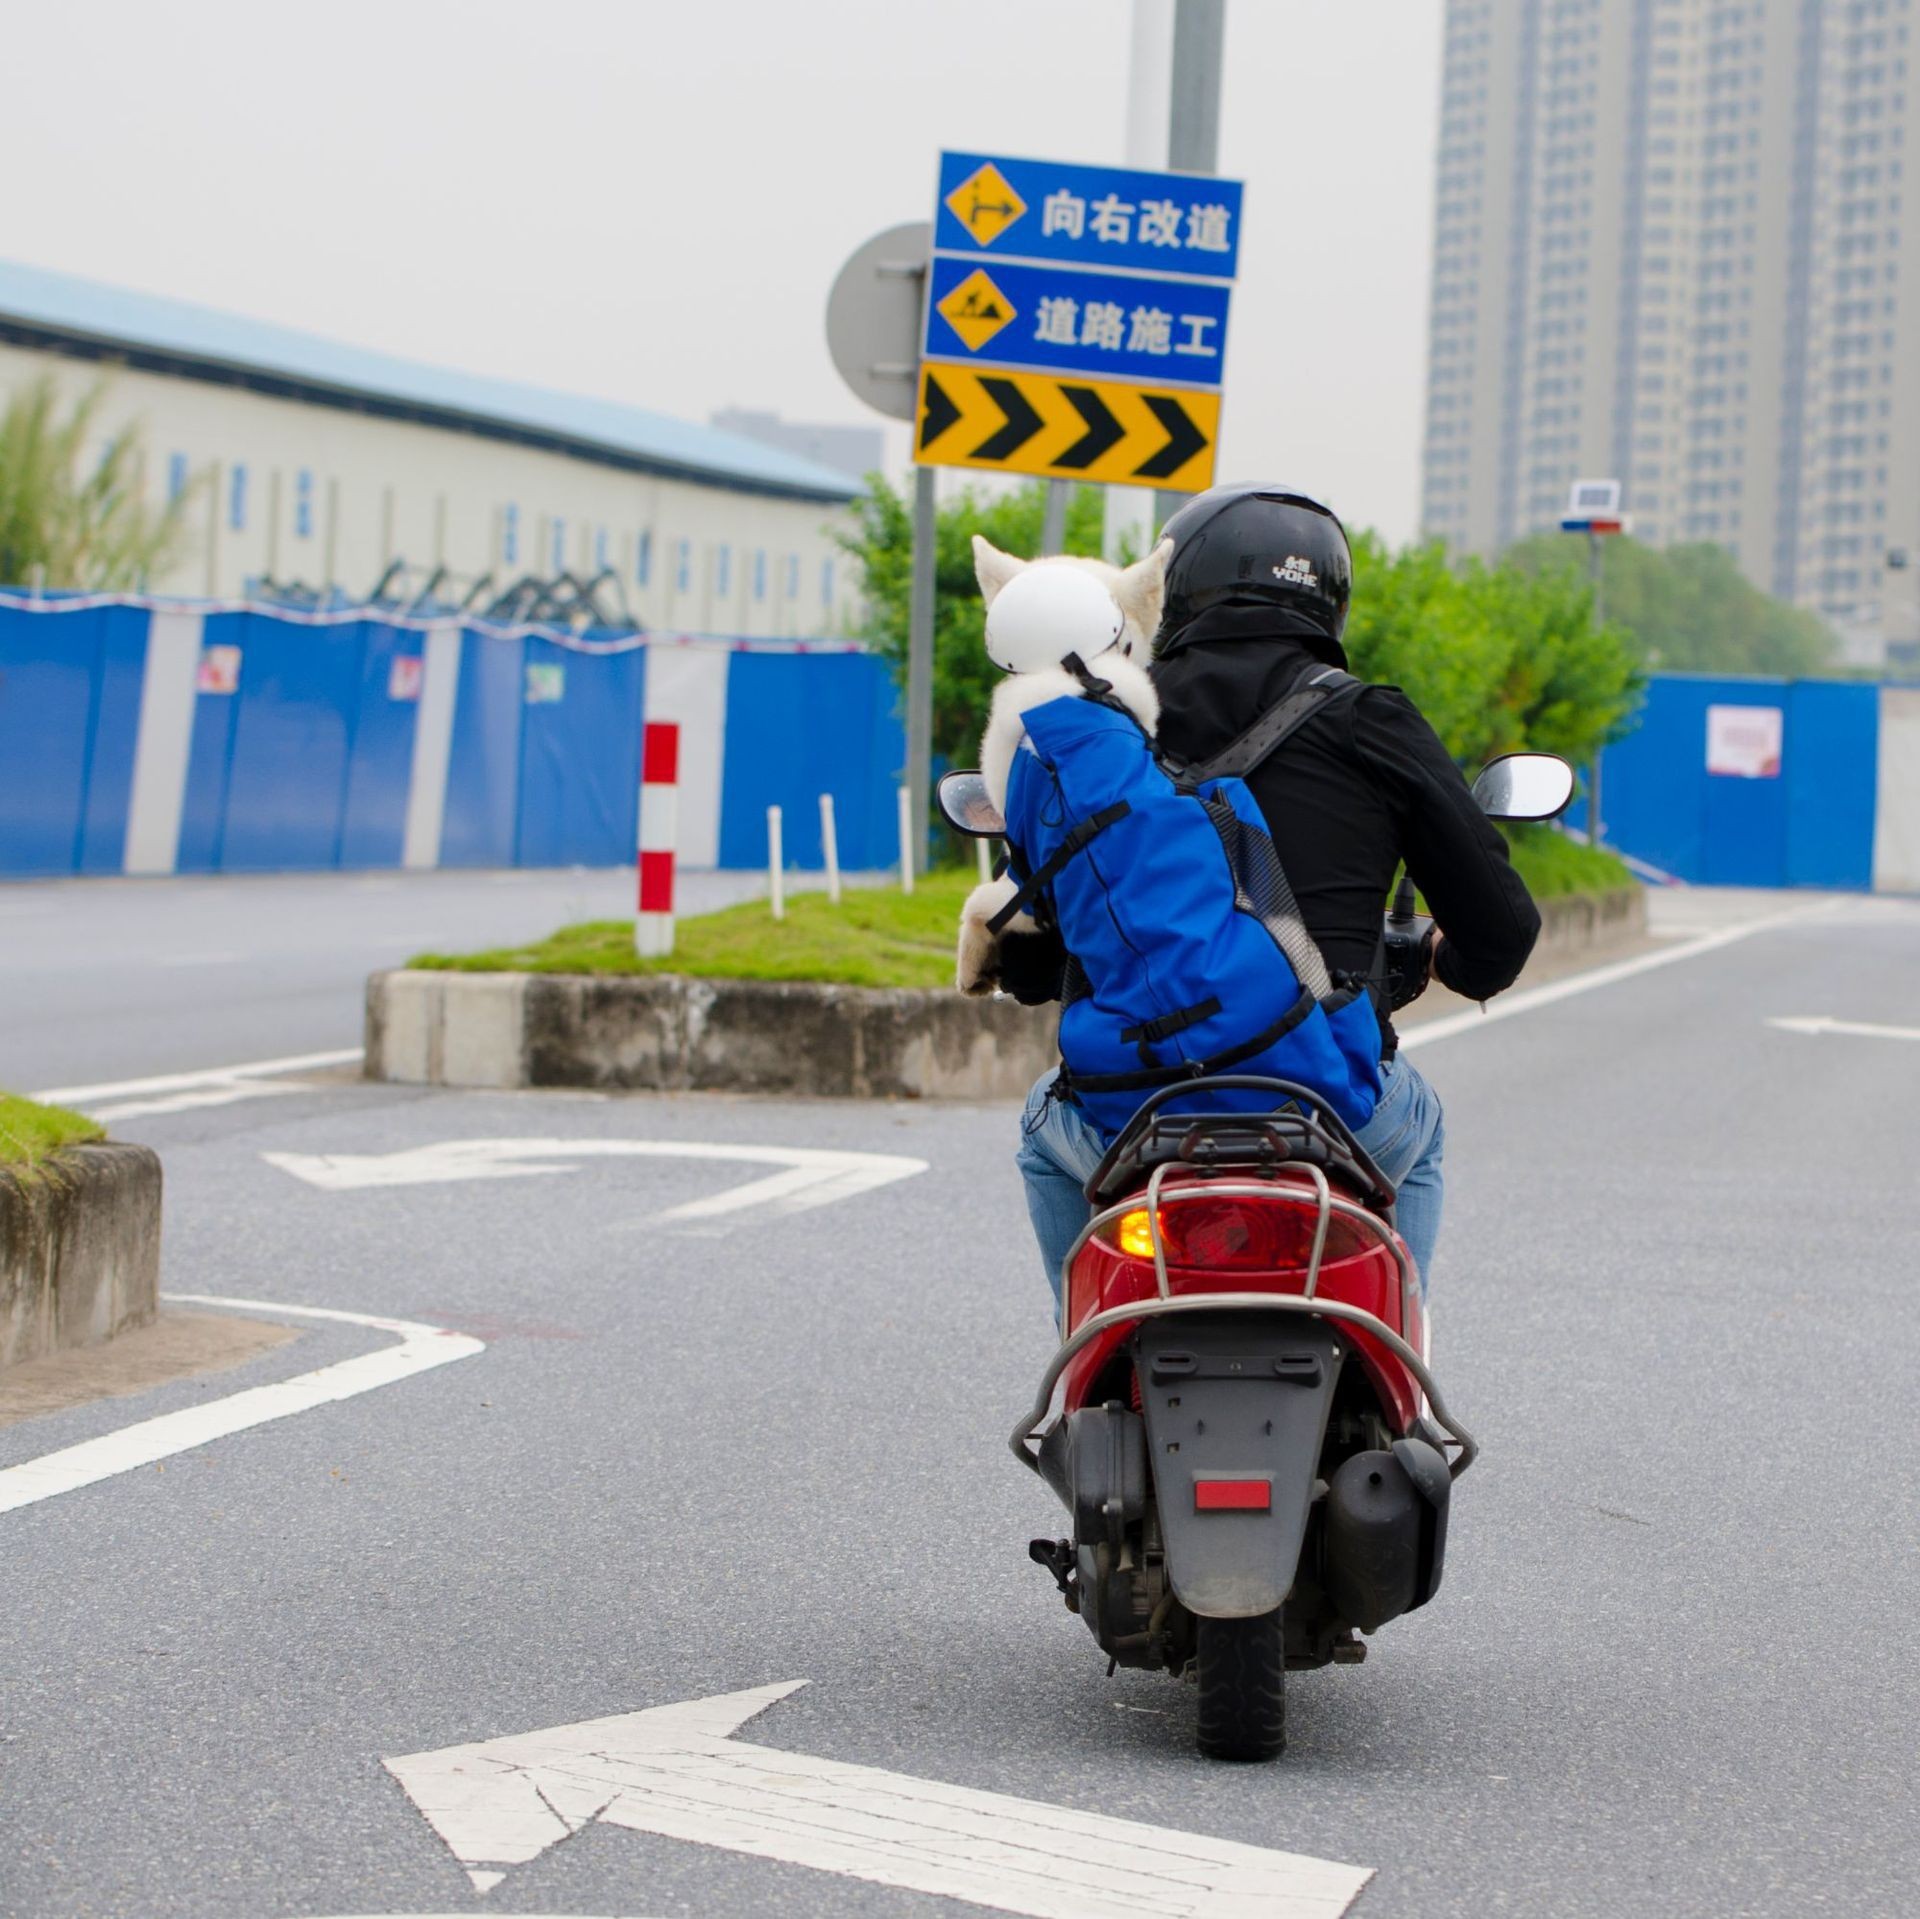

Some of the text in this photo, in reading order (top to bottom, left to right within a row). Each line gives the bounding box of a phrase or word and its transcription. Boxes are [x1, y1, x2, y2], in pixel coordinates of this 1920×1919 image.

[1042, 189, 1231, 252] 向右改道
[1034, 296, 1218, 357] 道路施工
[1272, 566, 1317, 587] YOHE
